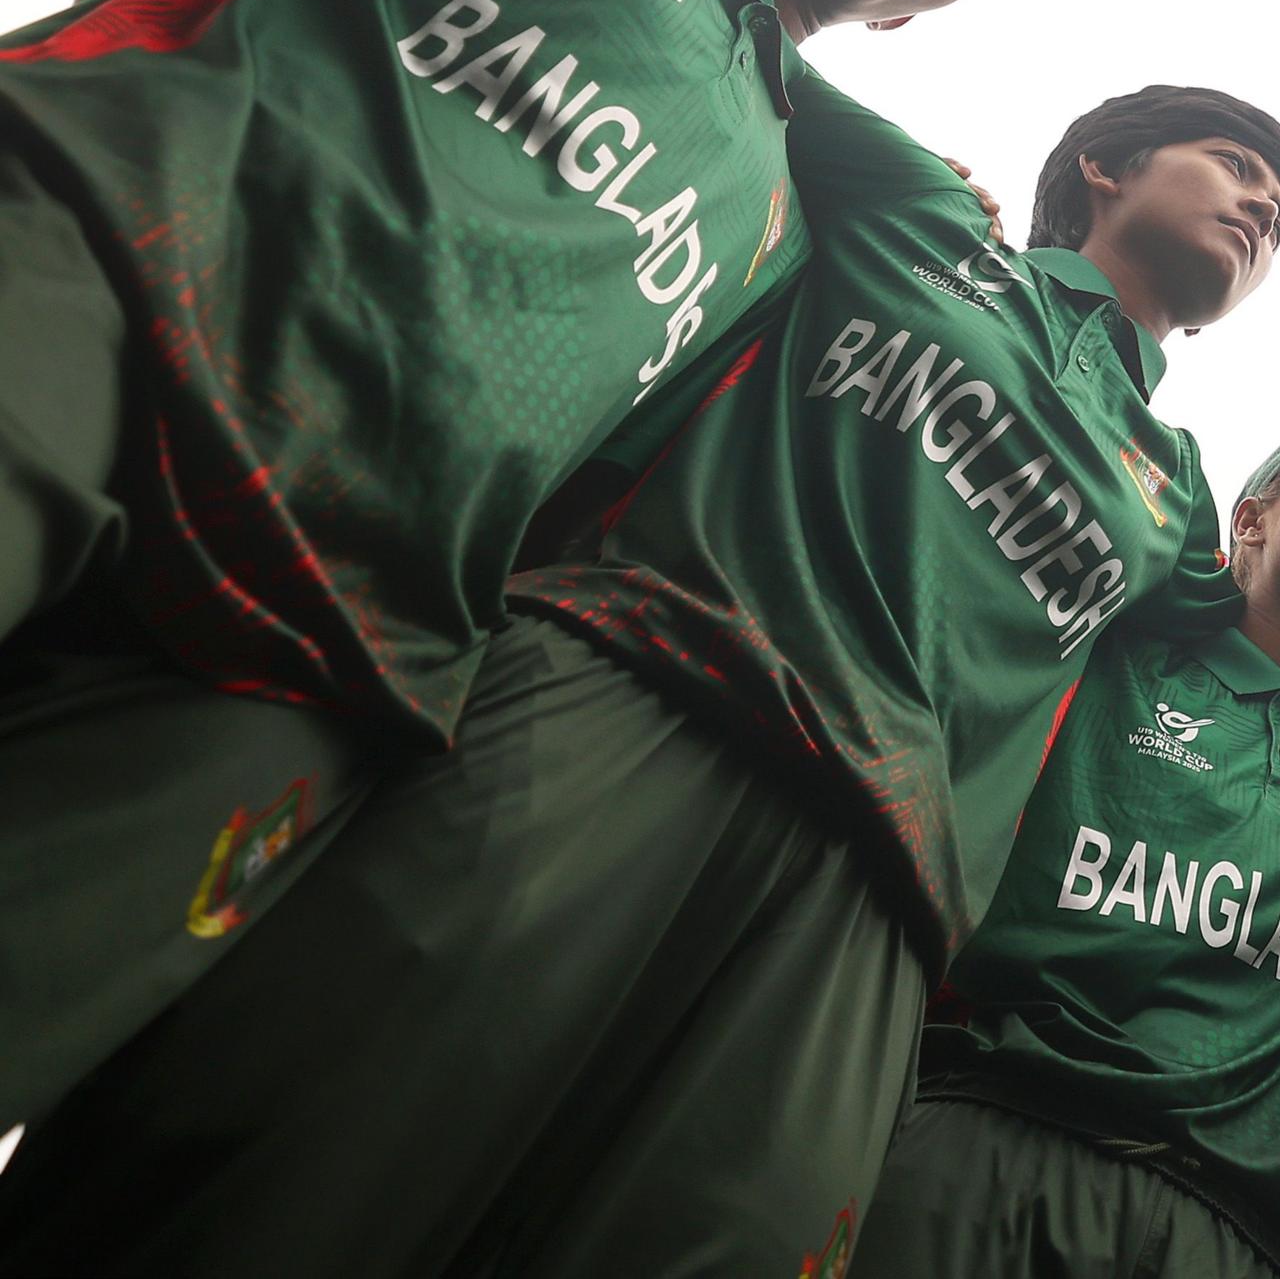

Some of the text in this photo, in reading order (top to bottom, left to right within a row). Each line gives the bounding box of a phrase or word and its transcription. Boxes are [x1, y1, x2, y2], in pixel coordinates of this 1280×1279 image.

[912, 264, 999, 311] WORLD CU
[804, 317, 1127, 660] BANGLADESH
[1137, 727, 1154, 735] U19
[1128, 734, 1214, 771] WORLD CUP
[1138, 747, 1201, 772] MALAYSIA 2025
